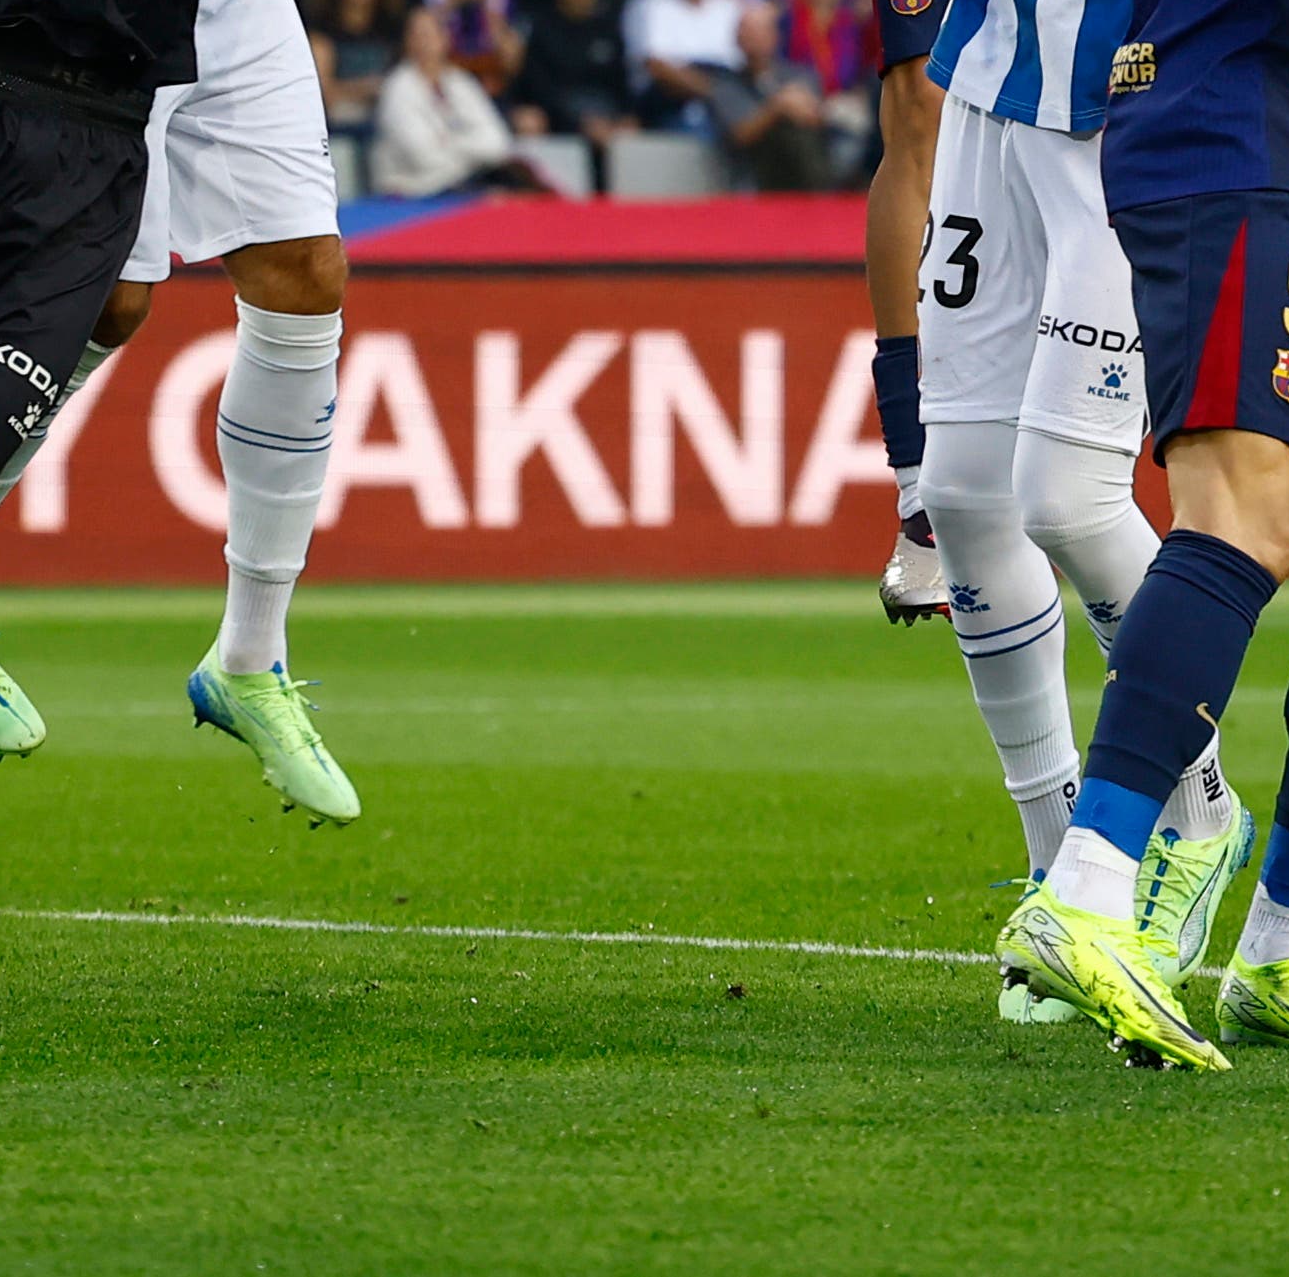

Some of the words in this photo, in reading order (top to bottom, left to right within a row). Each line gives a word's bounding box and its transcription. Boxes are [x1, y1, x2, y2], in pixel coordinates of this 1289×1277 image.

[917, 210, 983, 309] 3
[1037, 314, 1144, 354] SKODA
[1087, 385, 1131, 402] KELME
[8, 415, 29, 441] KEL
